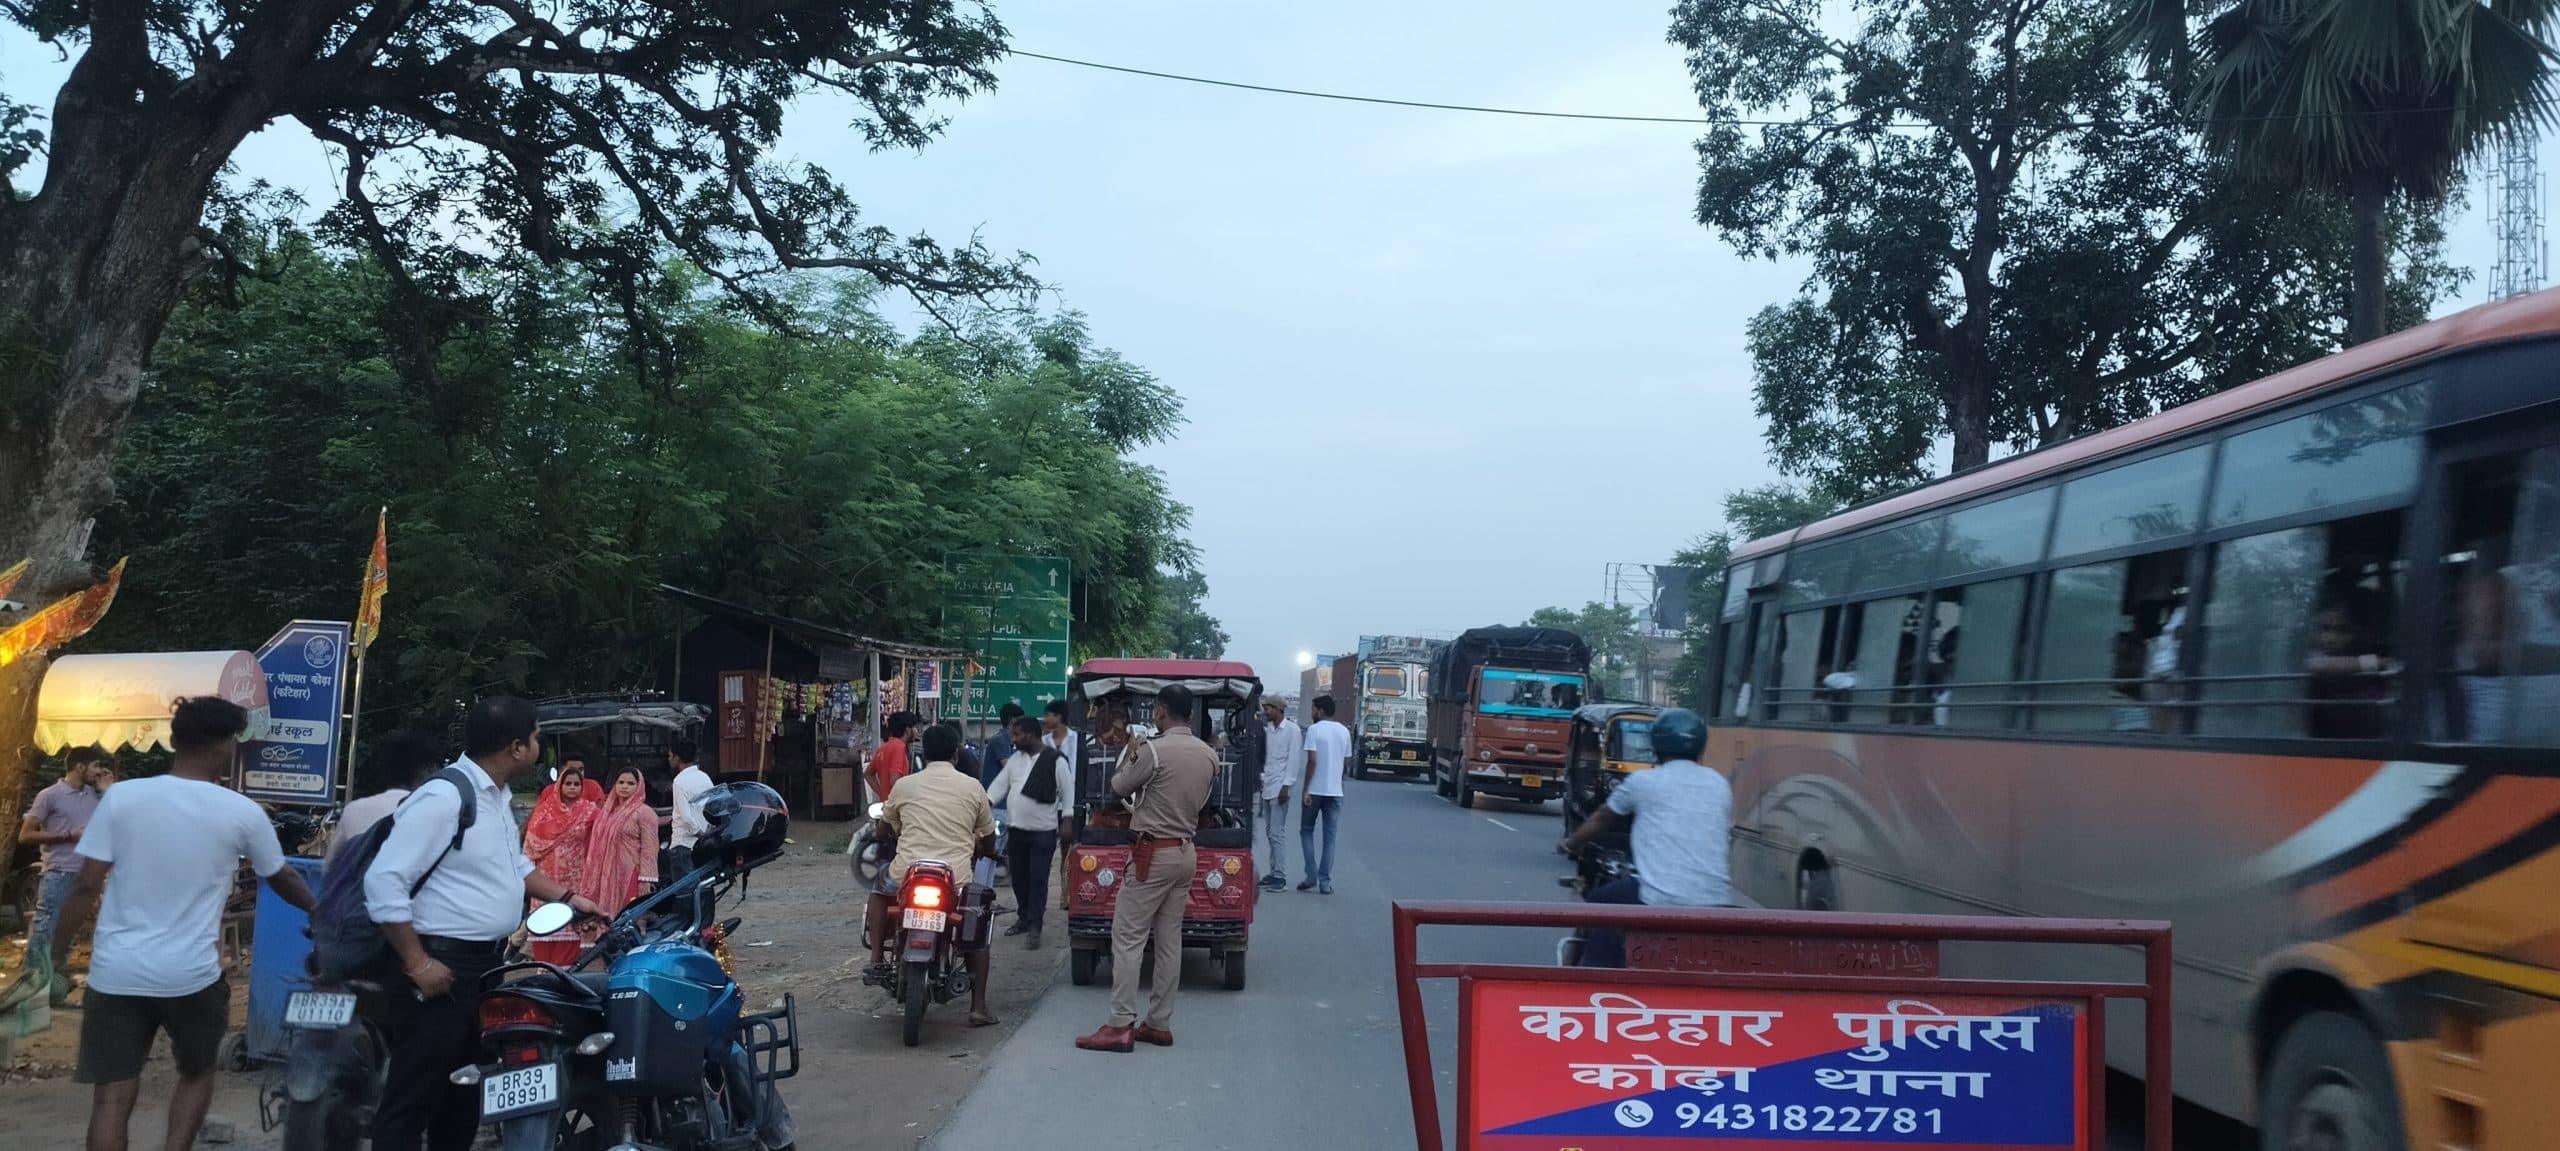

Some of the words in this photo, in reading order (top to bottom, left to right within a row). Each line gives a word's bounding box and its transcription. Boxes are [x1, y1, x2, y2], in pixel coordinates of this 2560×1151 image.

[285, 726, 315, 739] स्कूल
[1519, 993, 1783, 1047] कटिहार
[1833, 1000, 2040, 1062] पुलिस
[503, 1068, 543, 1091] BR39
[1568, 1054, 1756, 1096] कोढ़ा
[1814, 1068, 1991, 1098] थाना
[1675, 1103, 1941, 1134] 9431822781
